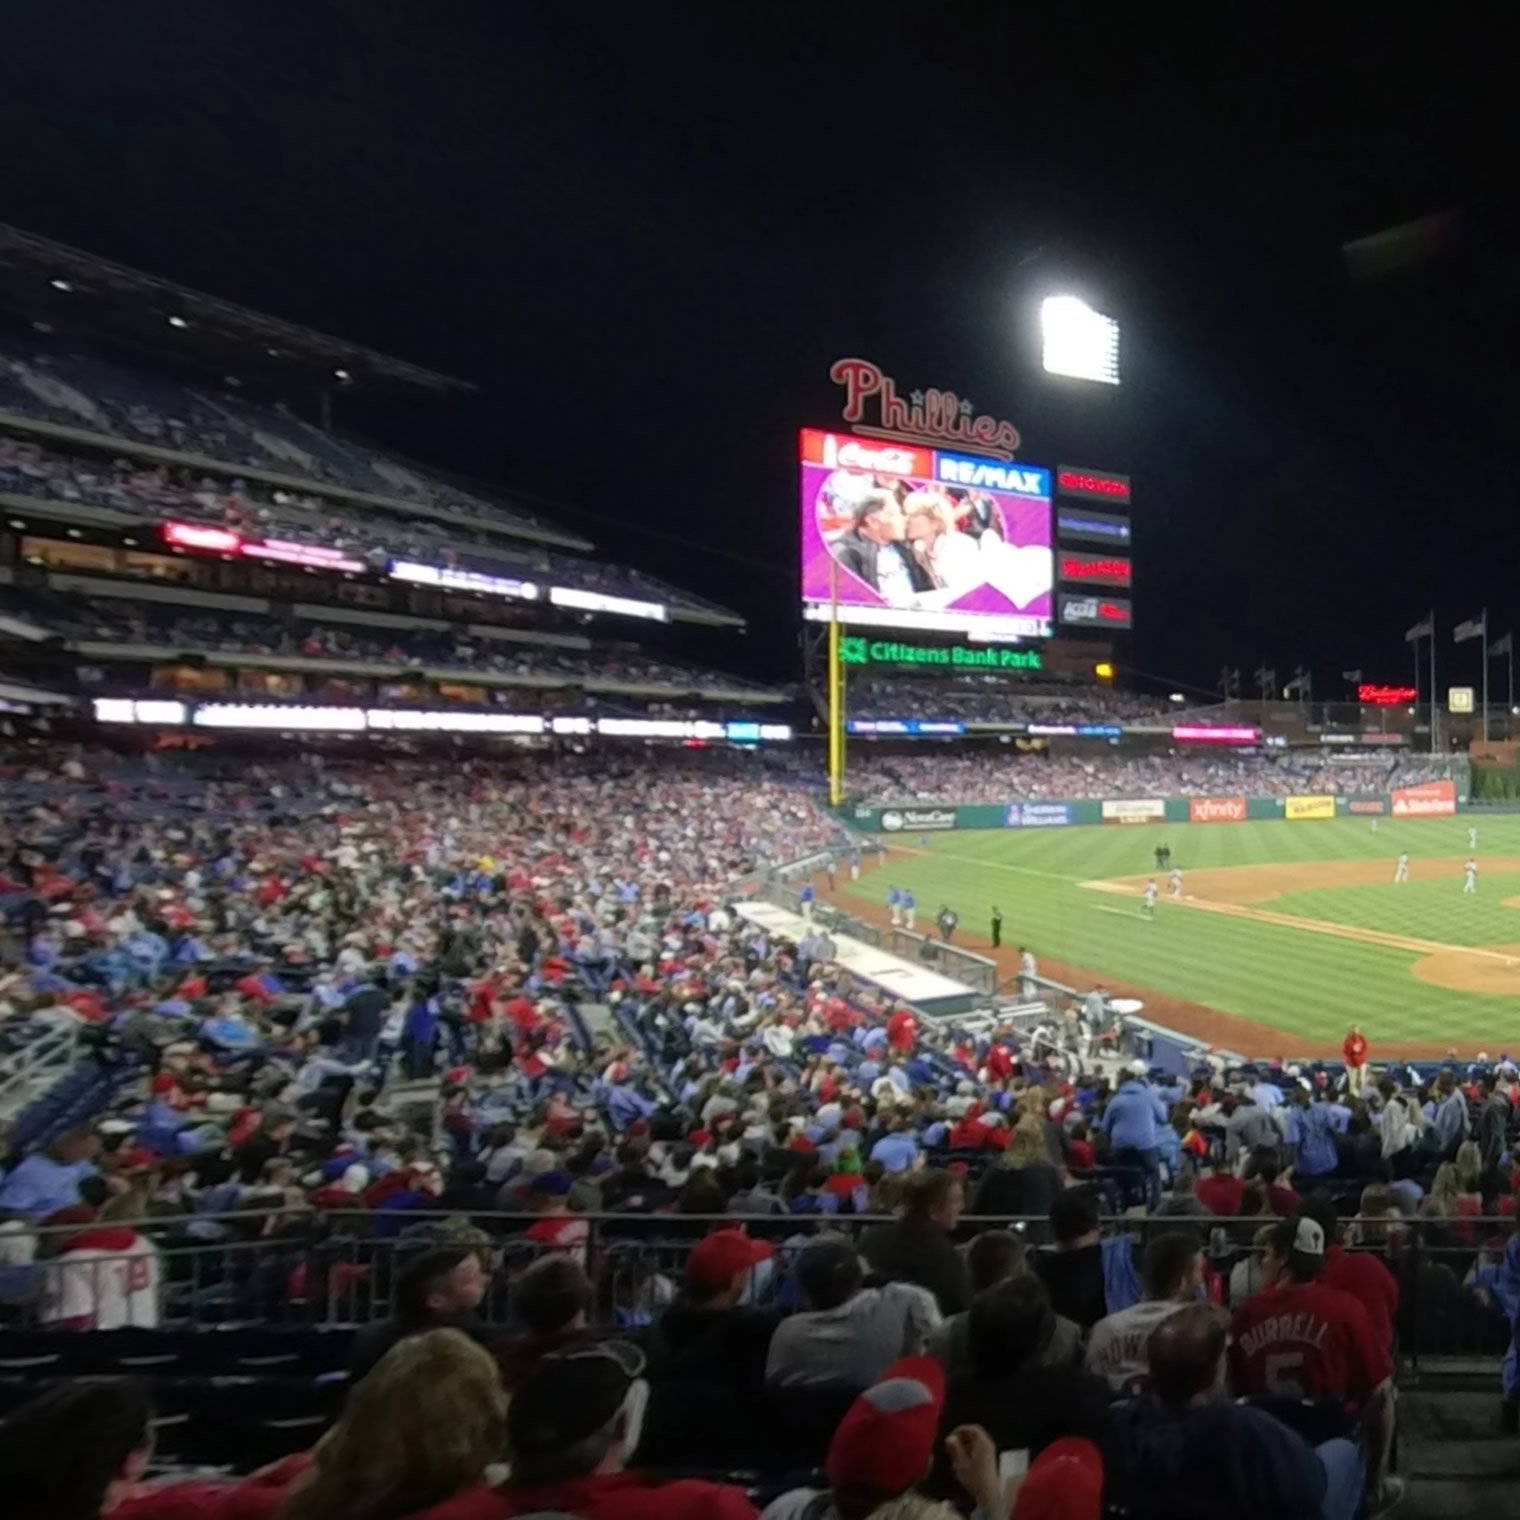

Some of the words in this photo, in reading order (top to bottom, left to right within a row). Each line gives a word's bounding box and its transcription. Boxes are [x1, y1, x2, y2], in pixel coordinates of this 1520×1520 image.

[831, 358, 1020, 452] Phillies
[940, 458, 1042, 494] RE/MAX
[870, 642, 949, 664] Citizens
[952, 647, 997, 667] Bank
[1001, 650, 1040, 669] Park
[1194, 801, 1242, 819] xfinity
[1239, 1311, 1328, 1357] BURRELL
[1264, 1351, 1304, 1395] 5
